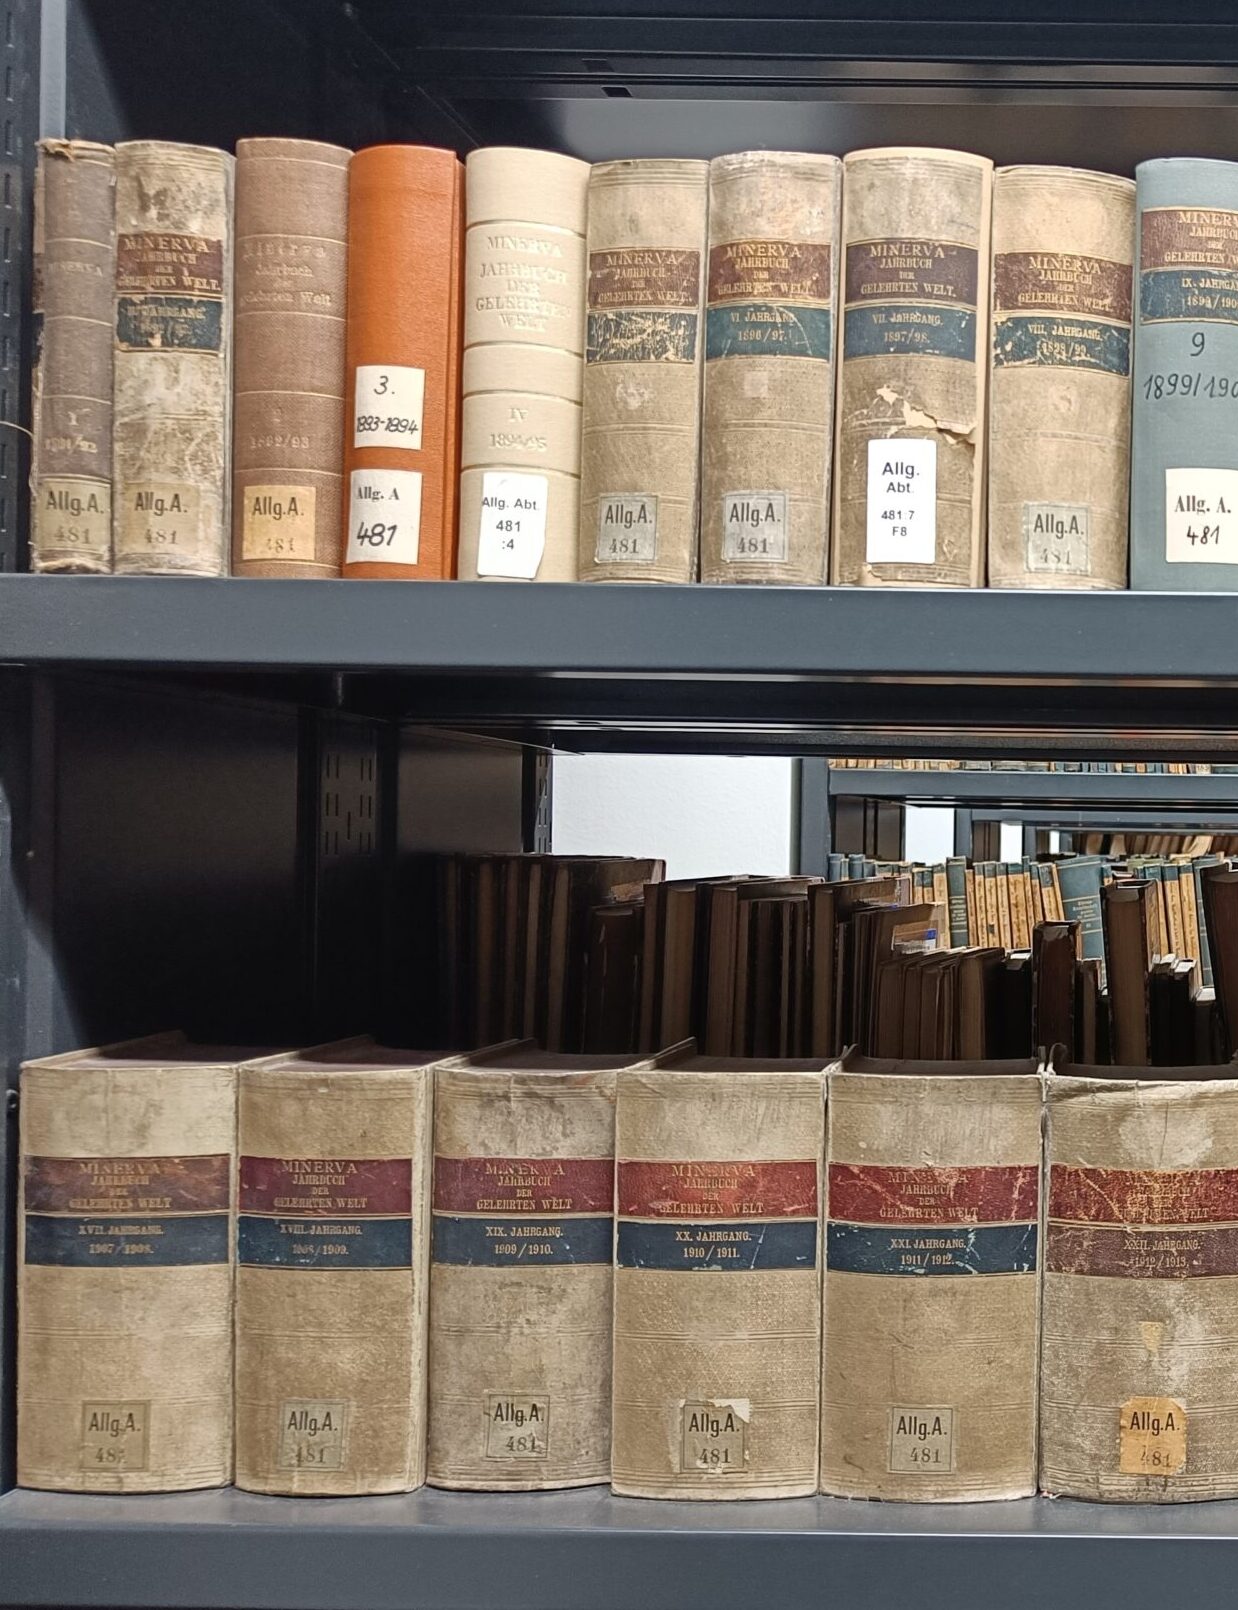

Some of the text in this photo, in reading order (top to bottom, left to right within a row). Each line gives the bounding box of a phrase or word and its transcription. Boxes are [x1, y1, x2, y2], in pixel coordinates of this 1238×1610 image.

[725, 243, 803, 259] MINERVA
[870, 244, 946, 260] MINERVA
[606, 254, 680, 268] MINERVA
[735, 257, 790, 270] JAHRBUCH
[879, 258, 933, 270] JAHRBUCH
[1028, 256, 1102, 275] MINERVA
[923, 284, 957, 298] WELT.
[1190, 331, 1205, 357] 9
[373, 375, 395, 395] 3.
[881, 461, 920, 480] Allg.
[356, 486, 385, 503] Allg.
[251, 496, 305, 520] Allg.A.
[481, 496, 510, 511] Allg.
[1174, 495, 1233, 515] Allg. A.
[604, 504, 653, 529] Allg.A.
[729, 502, 781, 527] Allg.A.
[356, 521, 398, 547] 481
[495, 520, 522, 533] 481
[892, 526, 908, 537] F8
[1033, 513, 1084, 539] Allg.A.
[1186, 525, 1220, 546] 481
[607, 538, 640, 554] 481
[736, 538, 770, 554] 481
[78, 1162, 160, 1175] MINERVA
[280, 1160, 358, 1175] MINERVA
[671, 1164, 757, 1177] MINERVA
[292, 1174, 346, 1186] JAHRBUCH
[498, 1175, 552, 1187] JAHRBUCH
[684, 1178, 738, 1190] JAHRBUCH
[311, 1187, 330, 1195] DER
[516, 1188, 532, 1197] DER
[274, 1197, 369, 1209] GELEHRTEN WELT
[476, 1198, 573, 1210] GELEHRTEN WELT
[732, 1202, 765, 1214] WELT
[919, 1197, 935, 1205] DER
[948, 1207, 980, 1220] WELT
[485, 1226, 565, 1239] XIX. JAHRGANG.
[675, 1231, 753, 1242] XX. JAHRGANG.
[913, 1238, 967, 1250] JAHRGANG.
[493, 1403, 545, 1427] Allg.A.
[88, 1412, 142, 1437] Allg.A.
[287, 1411, 339, 1436] Allg.A.
[688, 1413, 741, 1438] Allg.A.
[896, 1416, 949, 1440] Allg.A.
[1129, 1411, 1181, 1437] Allg.A.
[505, 1435, 541, 1454] 481
[699, 1448, 733, 1465] 481
[909, 1447, 943, 1464] 481
